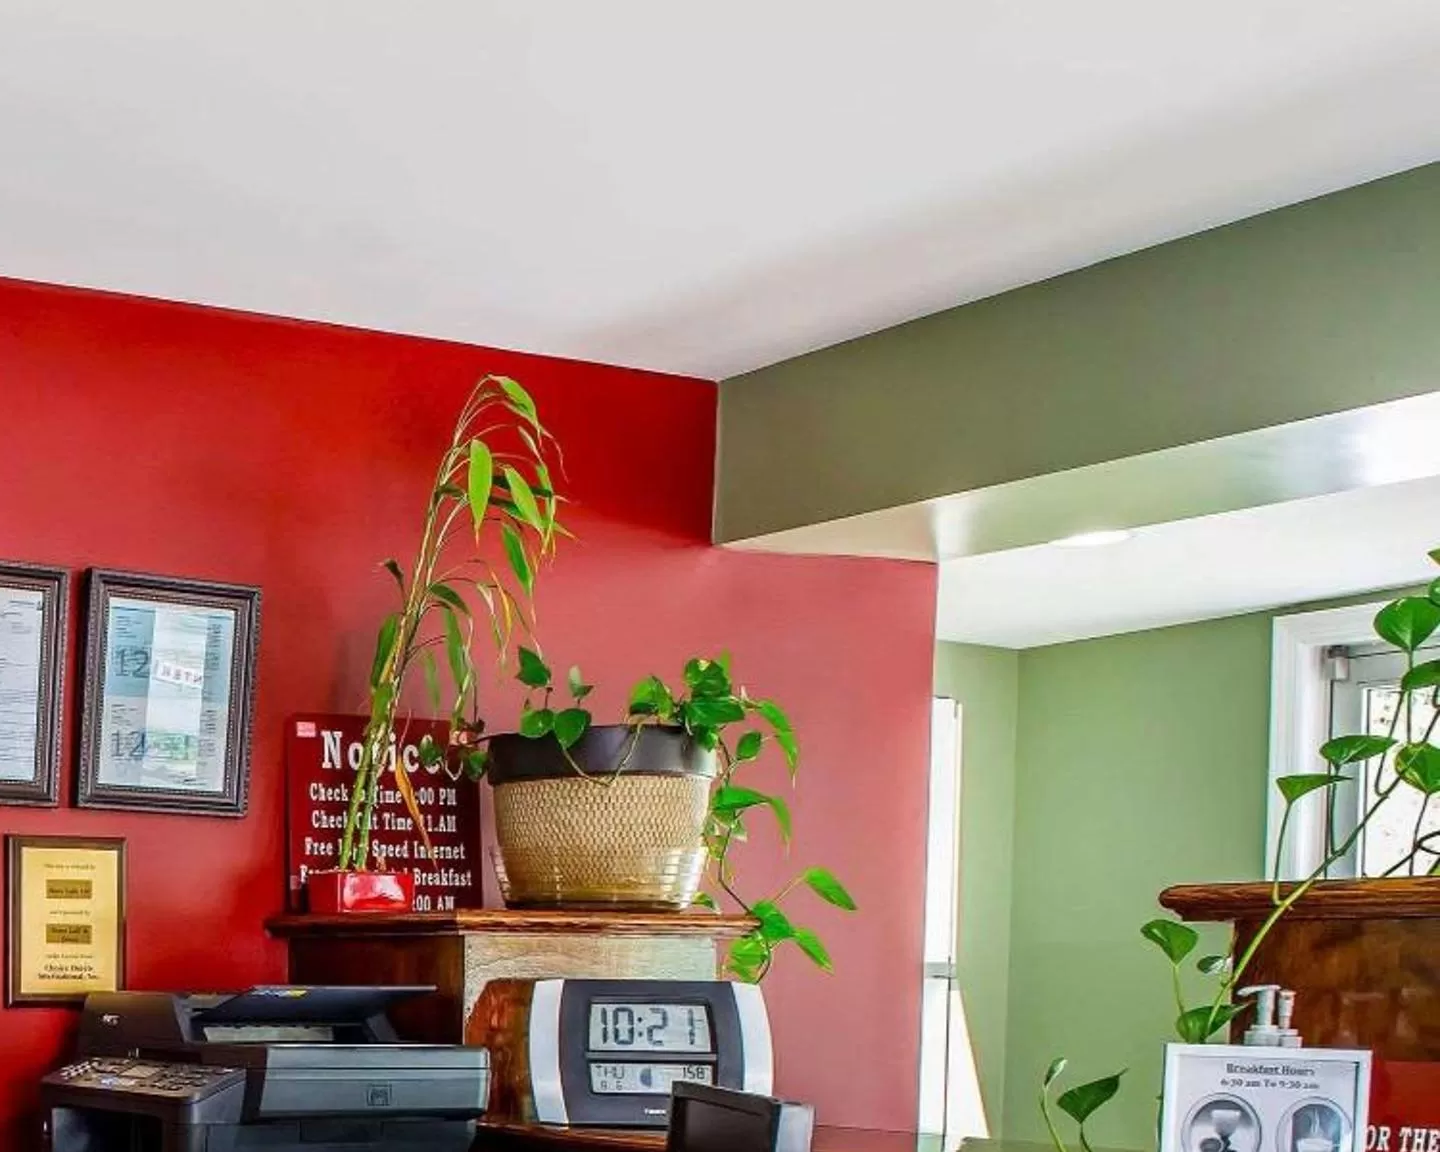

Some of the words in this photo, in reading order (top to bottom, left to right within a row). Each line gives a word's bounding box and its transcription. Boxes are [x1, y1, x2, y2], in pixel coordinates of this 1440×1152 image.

[310, 782, 349, 802] Check
[414, 787, 435, 806] :00
[439, 788, 458, 806] PM
[382, 812, 413, 831] Time
[304, 836, 333, 856] Free
[372, 838, 409, 858] Speed
[414, 868, 472, 887] Breakfast
[437, 896, 456, 912] AM
[599, 1007, 696, 1046] 10:21
